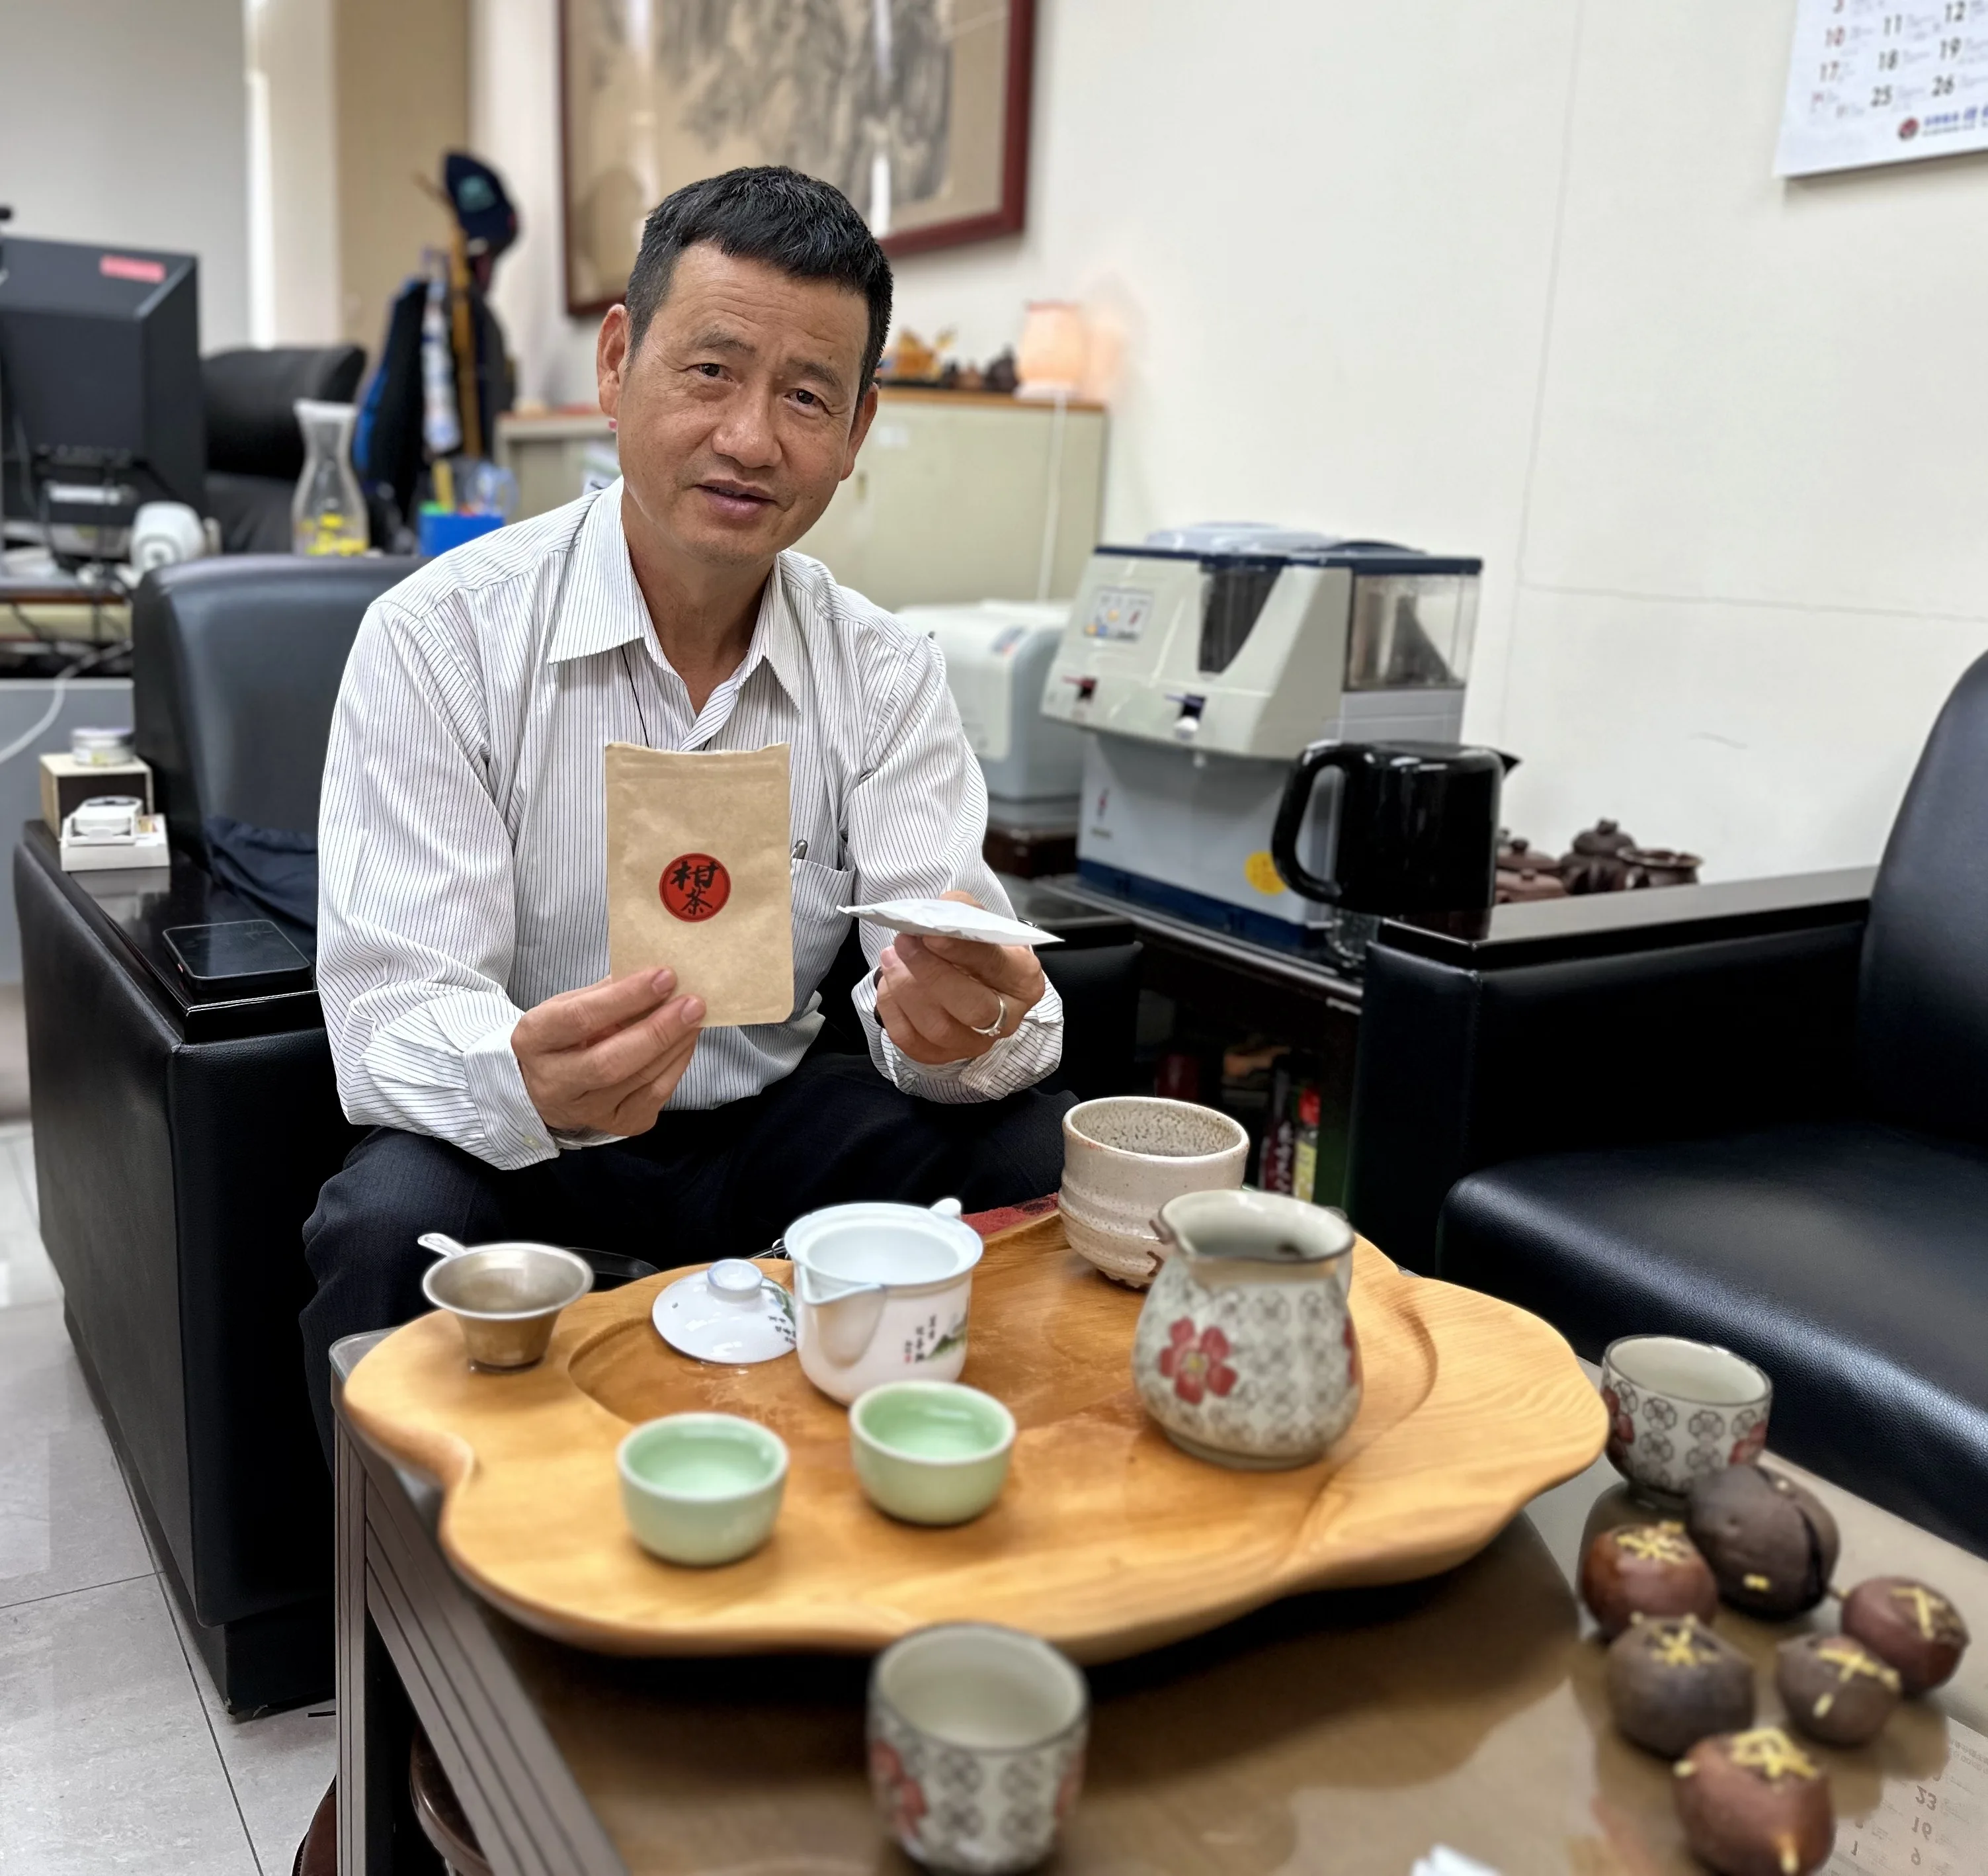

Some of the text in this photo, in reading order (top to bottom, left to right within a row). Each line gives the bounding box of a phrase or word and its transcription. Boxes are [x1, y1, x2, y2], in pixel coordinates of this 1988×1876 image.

[1884, 13, 1903, 36] 11
[1944, 0, 1966, 22] 12
[1940, 36, 1962, 60] 19
[670, 860, 719, 916] 柑茶
